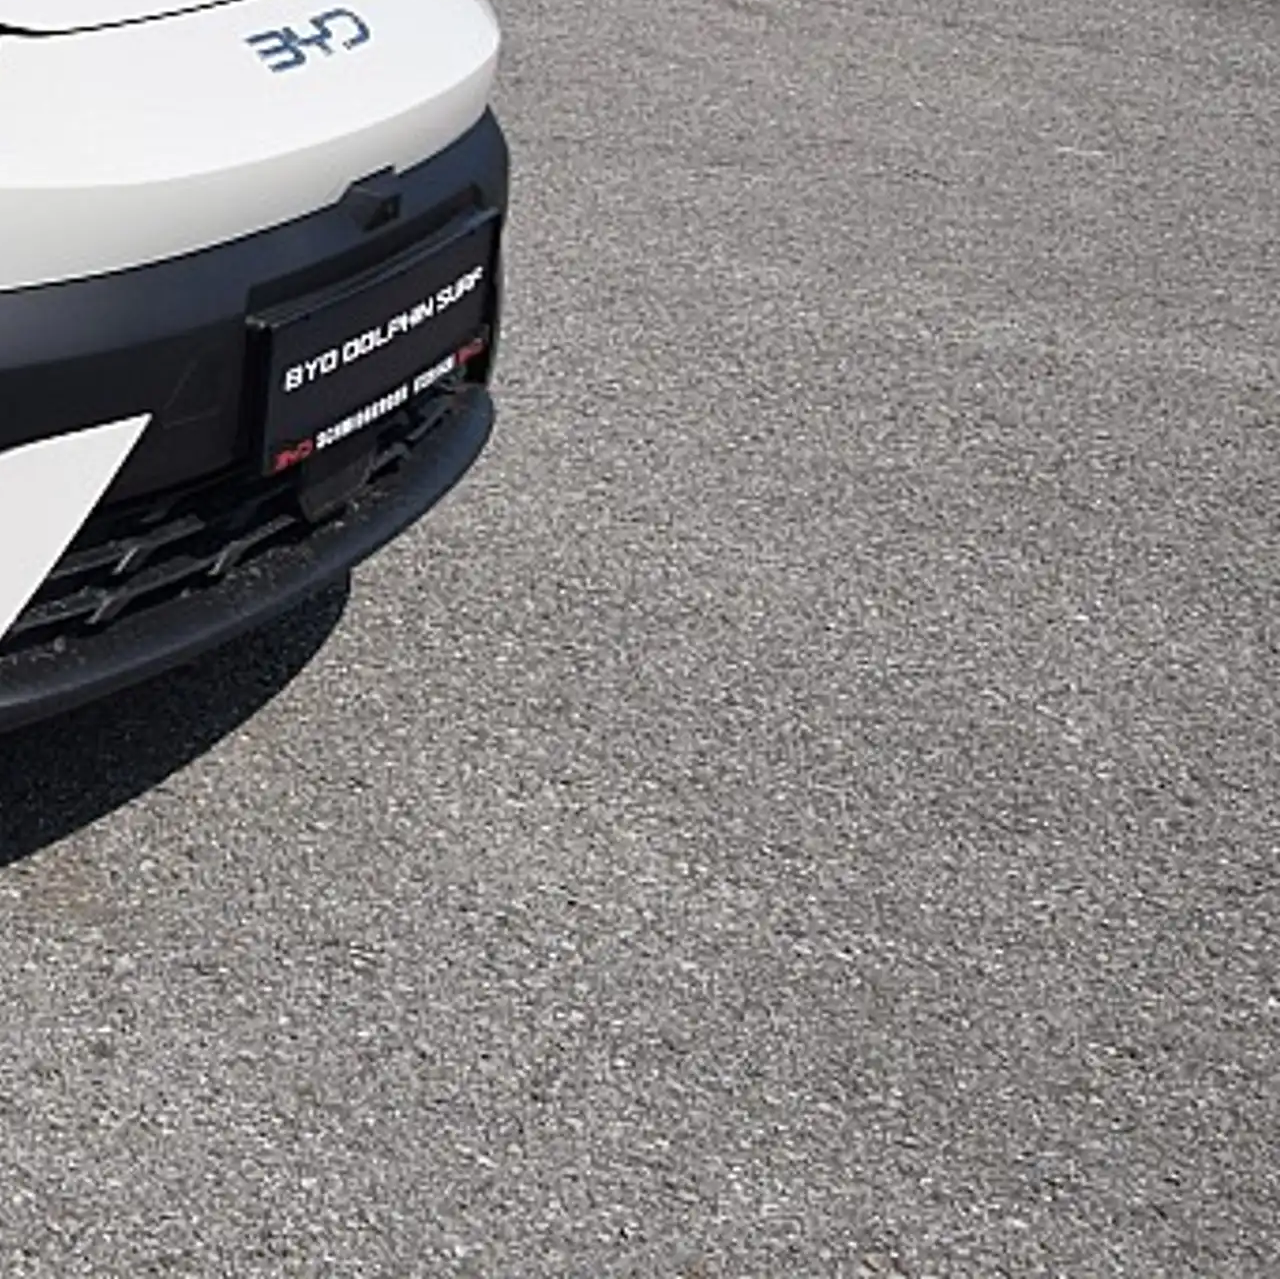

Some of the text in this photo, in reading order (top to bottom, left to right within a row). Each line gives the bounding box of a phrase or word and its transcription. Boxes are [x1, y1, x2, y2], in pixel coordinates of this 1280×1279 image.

[245, 8, 370, 73] BYD
[284, 348, 340, 392] BYD
[342, 296, 435, 364] DOLPHIN
